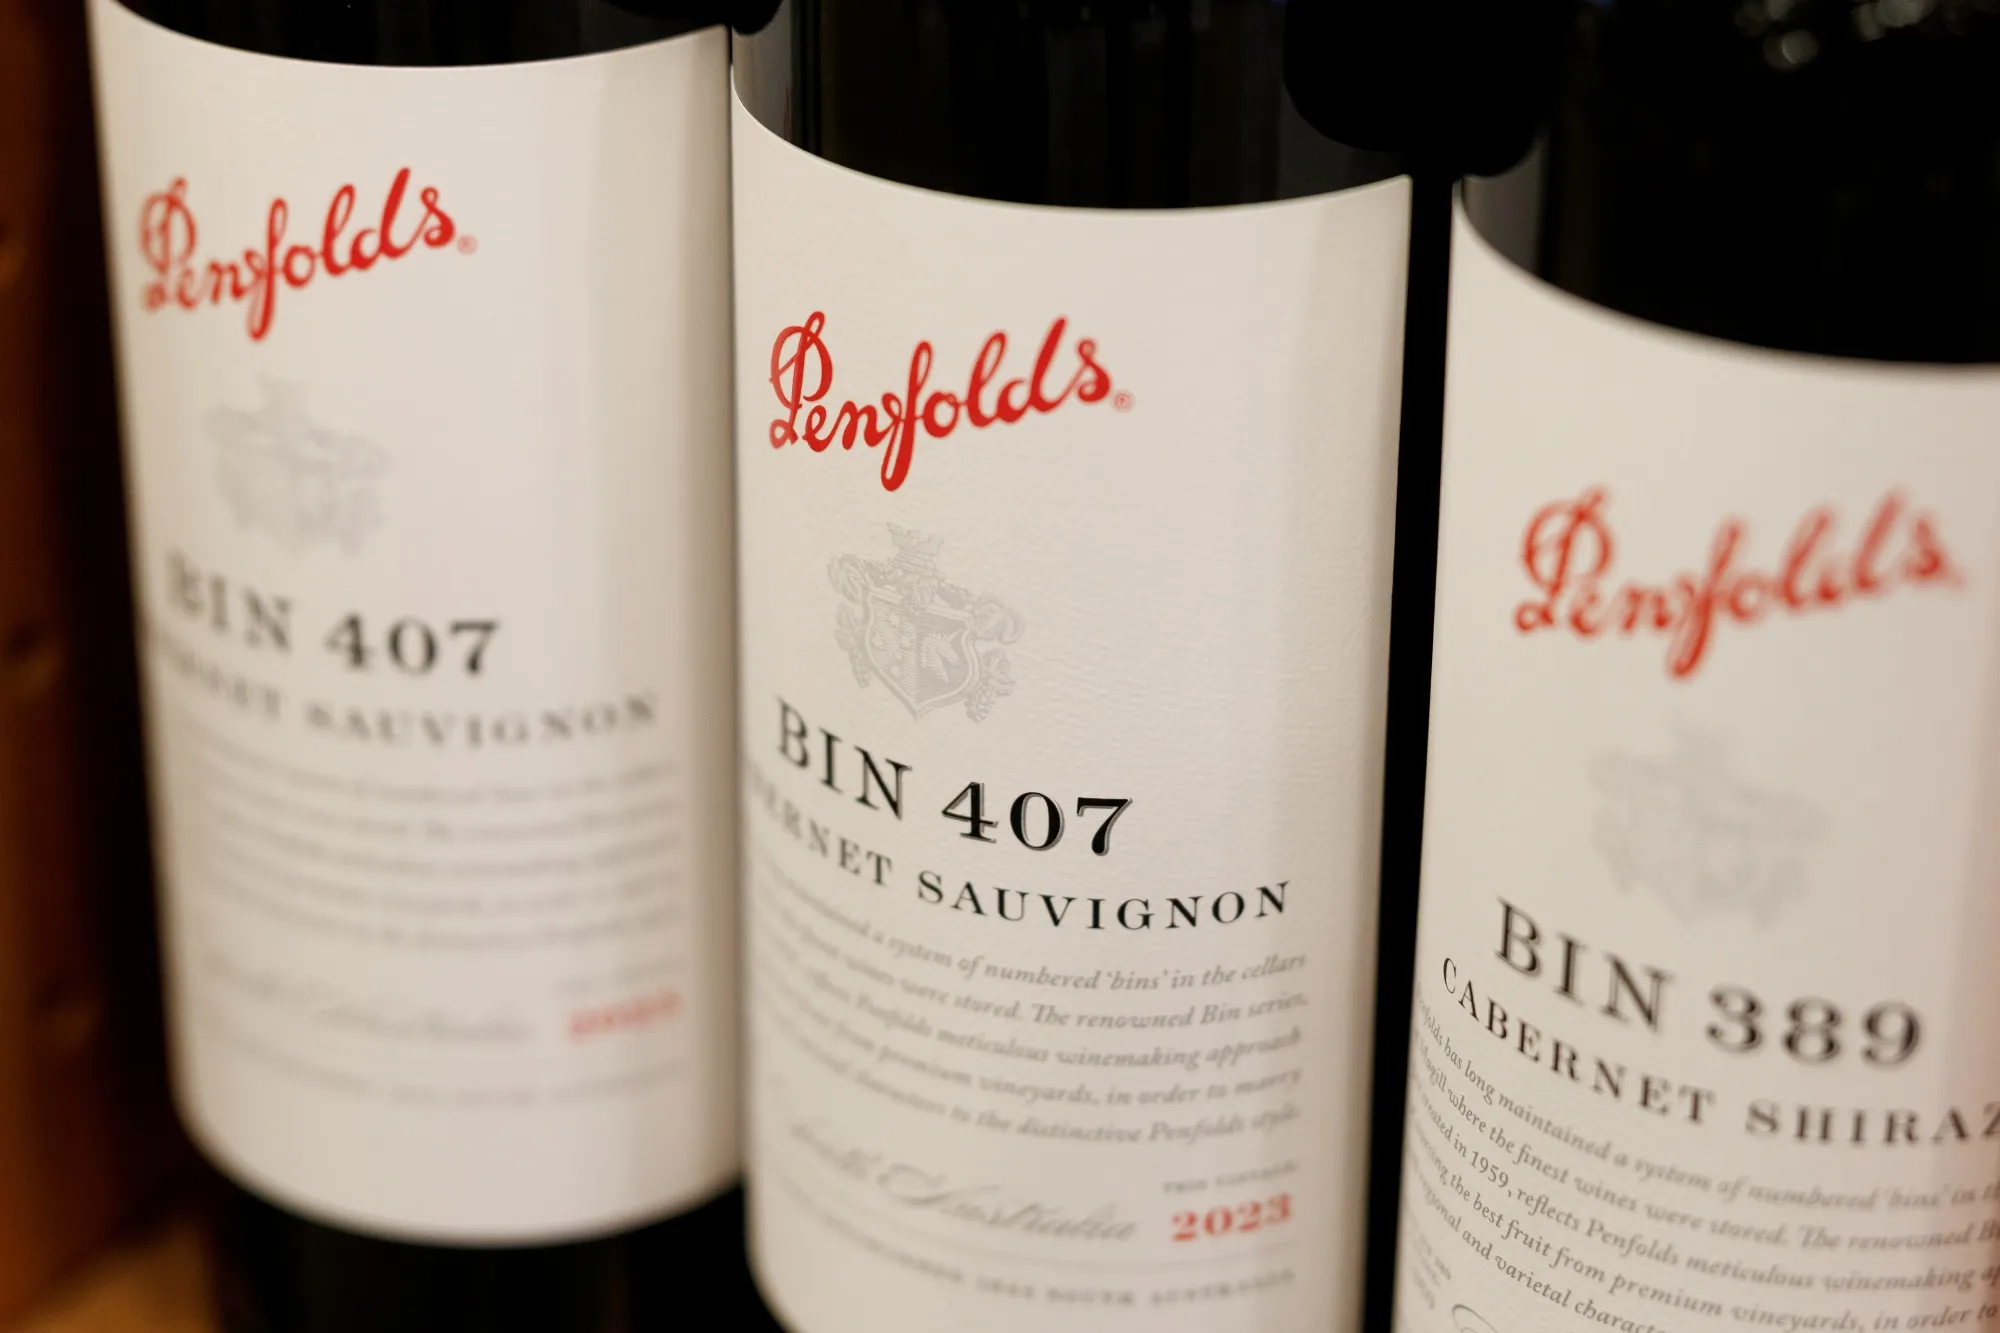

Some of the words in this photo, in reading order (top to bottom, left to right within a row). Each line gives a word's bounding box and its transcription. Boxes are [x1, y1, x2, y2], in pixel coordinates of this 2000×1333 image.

[138, 167, 456, 342] Penfolds
[769, 311, 1112, 491] Penfolds
[166, 552, 294, 655] BIN
[325, 611, 500, 677] 407
[1514, 485, 1952, 681] Penfolds
[777, 697, 912, 821] BIN
[941, 781, 1132, 857] 407
[917, 870, 1291, 931] SAUVIGNON
[956, 955, 985, 980] of
[984, 962, 1101, 990] numbered
[1171, 970, 1195, 989] in
[1202, 964, 1236, 987] the
[1241, 953, 1307, 980] cellars
[1030, 1002, 1070, 1028] The
[1076, 1006, 1195, 1029] renowned
[1200, 1003, 1242, 1025] Bin
[1056, 1046, 1200, 1071] winemaking
[1443, 957, 1718, 1126] CABERNET
[1495, 897, 1674, 1034] BIN
[1705, 984, 1923, 1069] 389
[1444, 1037, 1463, 1070] has
[1464, 1060, 1496, 1107] long
[1498, 1092, 1613, 1161] maintained
[1613, 1152, 1629, 1168] a
[1634, 1158, 1713, 1193] system
[1716, 1174, 1750, 1205] of
[1448, 1088, 1488, 1134] where
[1488, 1125, 1516, 1155] the
[1511, 1143, 1571, 1185] finest
[1573, 1175, 1638, 1212] wines
[1644, 1203, 1704, 1231] were
[1709, 1221, 1790, 1247] stored.
[1798, 1223, 1841, 1250] The
[1170, 1192, 1293, 1243] 2023
[1450, 1172, 1471, 1202] the
[1472, 1191, 1504, 1228] best
[1501, 1219, 1553, 1258] fruit
[1548, 1247, 1606, 1282] from
[1608, 1273, 1724, 1317] premium
[1872, 1311, 1900, 1331] in
[1906, 1305, 1973, 1331] order
[1453, 1133, 1468, 1158] in
[1469, 1151, 1513, 1198] 1959,
[1516, 1188, 1580, 1233] reflects
[1585, 1217, 1680, 1266] Penfolds
[1685, 1253, 1814, 1288] meticulous
[1821, 1265, 1976, 1296] winemaking
[1462, 1230, 1493, 1261] and
[1494, 1254, 1572, 1308] varietal
